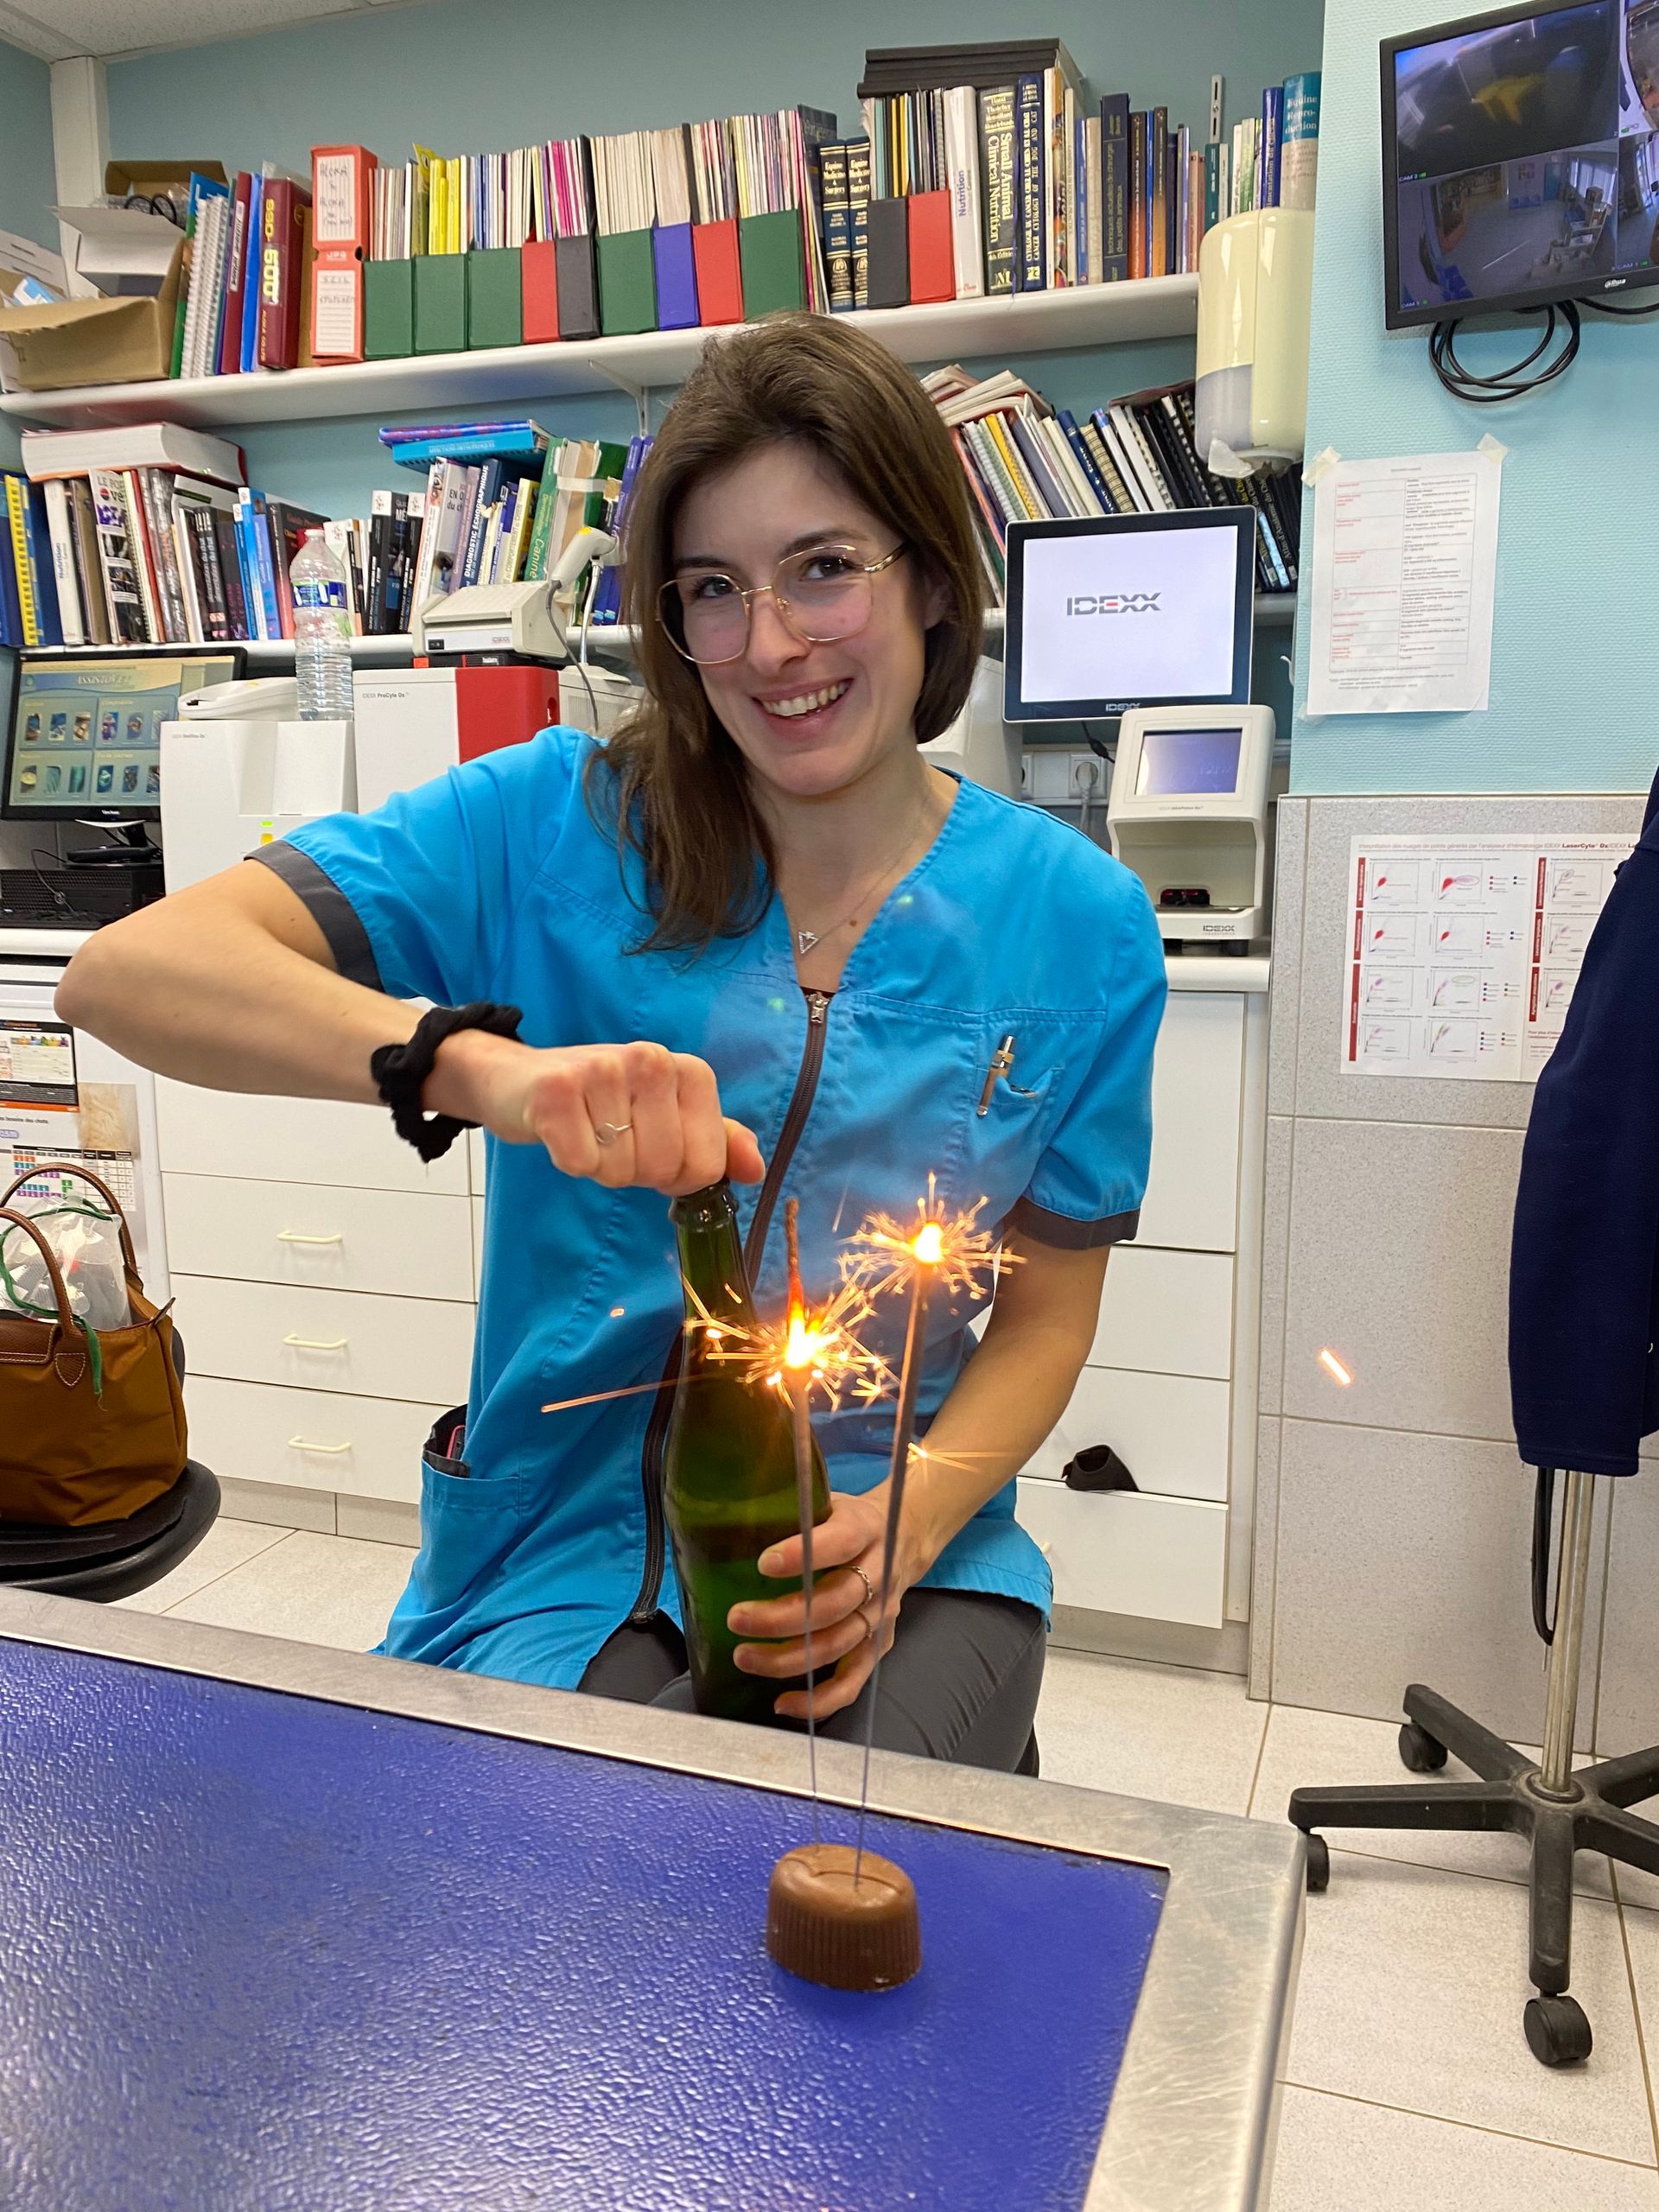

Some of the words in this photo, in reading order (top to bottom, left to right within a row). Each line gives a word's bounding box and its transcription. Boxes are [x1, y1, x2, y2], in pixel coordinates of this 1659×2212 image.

[1287, 95, 1318, 109] Equine
[1287, 110, 1316, 121] Repro-
[1285, 122, 1318, 134] duction
[1001, 133, 1013, 171] Small
[825, 161, 843, 171] Equine
[850, 159, 868, 169] Equine
[988, 136, 1000, 185] Clinical
[823, 170, 846, 180] Medicine
[849, 168, 870, 178] Medicine
[824, 186, 845, 195] Surgery
[850, 184, 870, 194] Surgery
[1032, 183, 1039, 192] OF
[1266, 160, 1274, 207] limentation
[958, 170, 967, 216] Nutrition
[1001, 172, 1014, 219] Animal
[988, 186, 1001, 243] Nutrition
[1107, 216, 1116, 254] techniques
[1032, 235, 1040, 261] CANCER
[97, 476, 108, 486] LE
[449, 490, 458, 499] EN
[447, 501, 455, 510] du
[464, 531, 477, 577] DIAGNOSTIC
[473, 465, 489, 530] ÉCHOGRAPHIQUE
[1268, 503, 1286, 540] d'Anatomie
[199, 537, 207, 552] chat
[1281, 540, 1292, 560] Atlas
[54, 542, 64, 579] Nutrition
[529, 538, 544, 579] Canine
[1067, 593, 1161, 616] IDEXX
[1105, 702, 1141, 712] IDEXX
